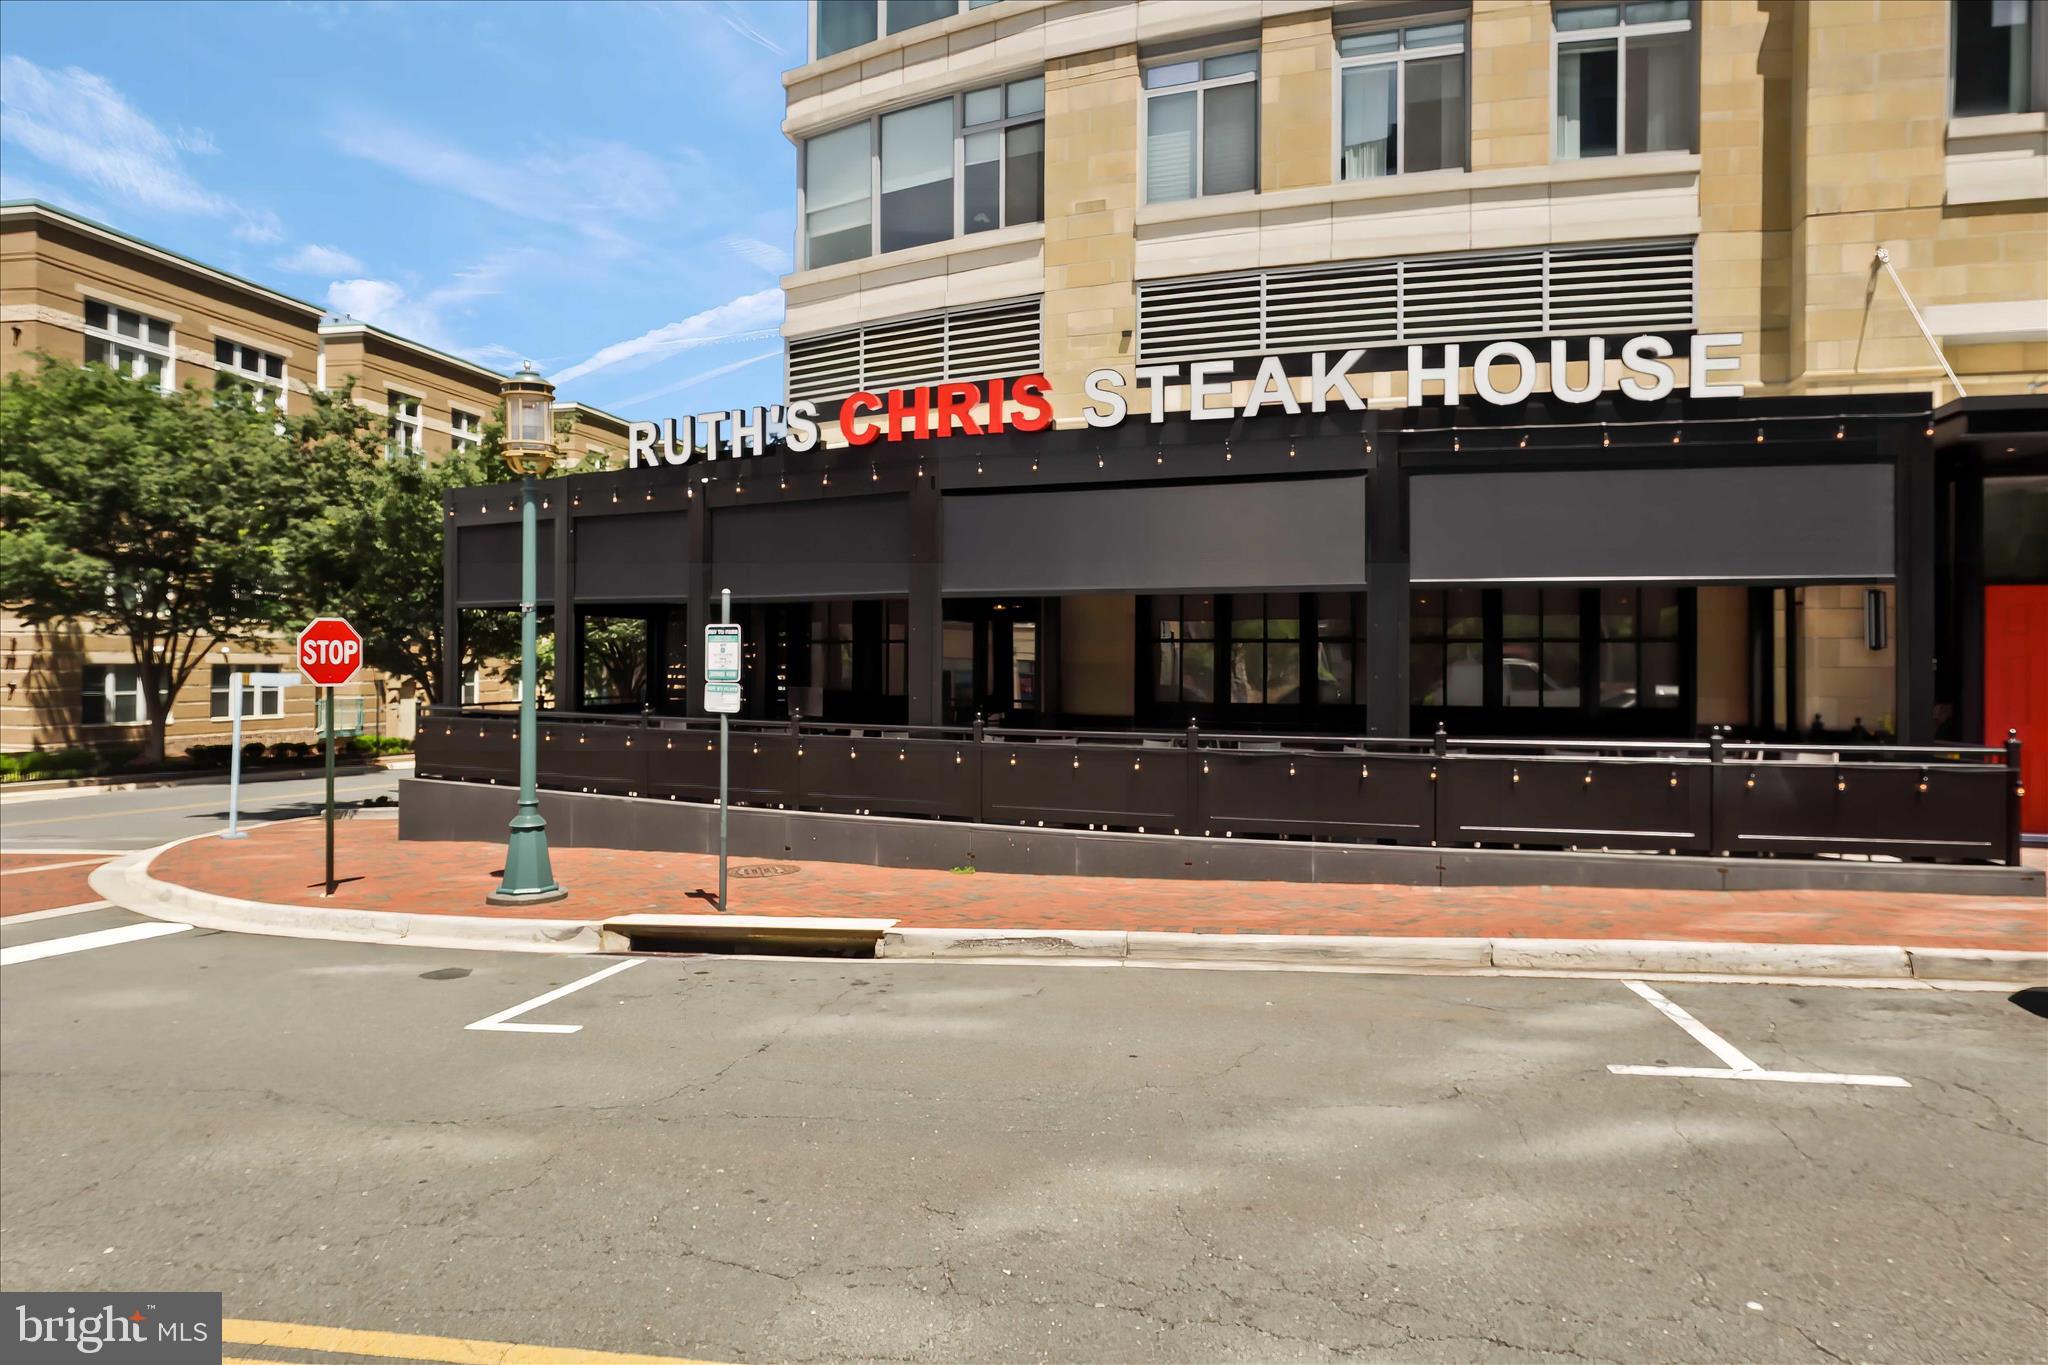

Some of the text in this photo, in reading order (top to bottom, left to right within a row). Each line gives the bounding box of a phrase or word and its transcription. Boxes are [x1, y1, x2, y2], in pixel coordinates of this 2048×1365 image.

[629, 333, 1744, 468] RUTH'S CHRIS STEAK HOUSE
[303, 640, 358, 665] STOP
